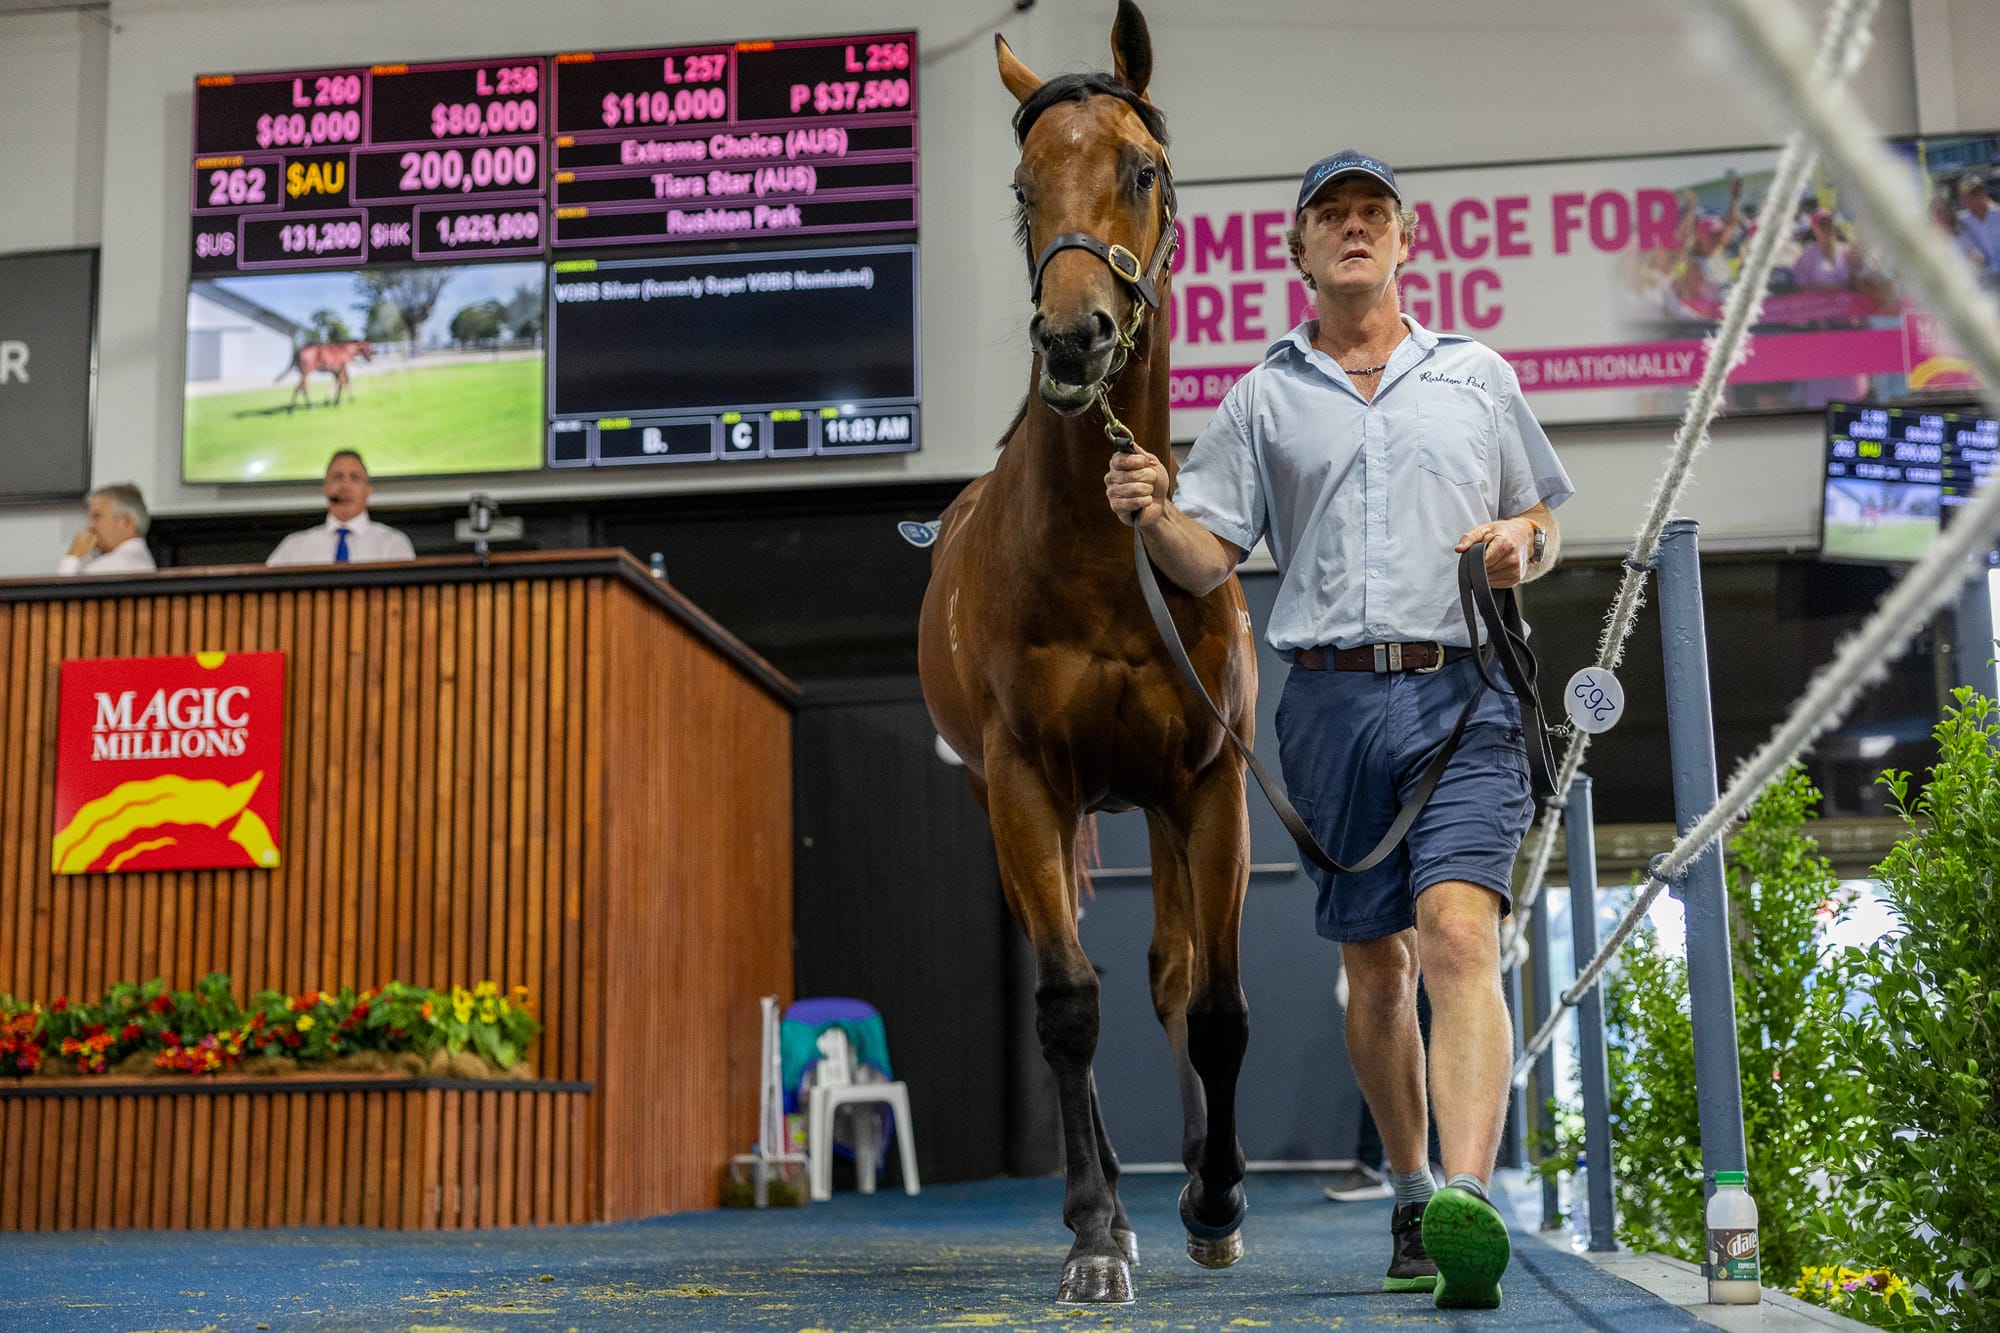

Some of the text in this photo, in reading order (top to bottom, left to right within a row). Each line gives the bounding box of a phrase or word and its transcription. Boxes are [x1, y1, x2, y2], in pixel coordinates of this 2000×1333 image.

[664, 54, 726, 84] L 257
[847, 42, 909, 72] L 256
[293, 75, 361, 107] L 260
[476, 69, 494, 96] L
[790, 78, 909, 113] P $37,500
[431, 99, 538, 138] $80,000
[602, 87, 726, 127] $110,000
[256, 110, 361, 149] $60,000
[621, 127, 848, 165] Extreme Choice (AUS)
[286, 160, 346, 199] $AU
[399, 145, 536, 192] 200,000
[651, 165, 817, 199] Tiara Star (AUS)
[208, 167, 266, 206] 262
[666, 203, 802, 234] Rushton Park
[1410, 196, 1532, 261] ACE
[1552, 187, 1682, 256] FOR
[279, 221, 362, 255] 131,200
[1288, 268, 1505, 333] MGIC
[1543, 349, 1695, 384] NATIONALLY
[731, 423, 753, 449] C
[877, 416, 910, 440] AM
[92, 685, 251, 733] MAGIC
[1574, 674, 1616, 722] 262
[91, 727, 249, 761] MILLIONS
